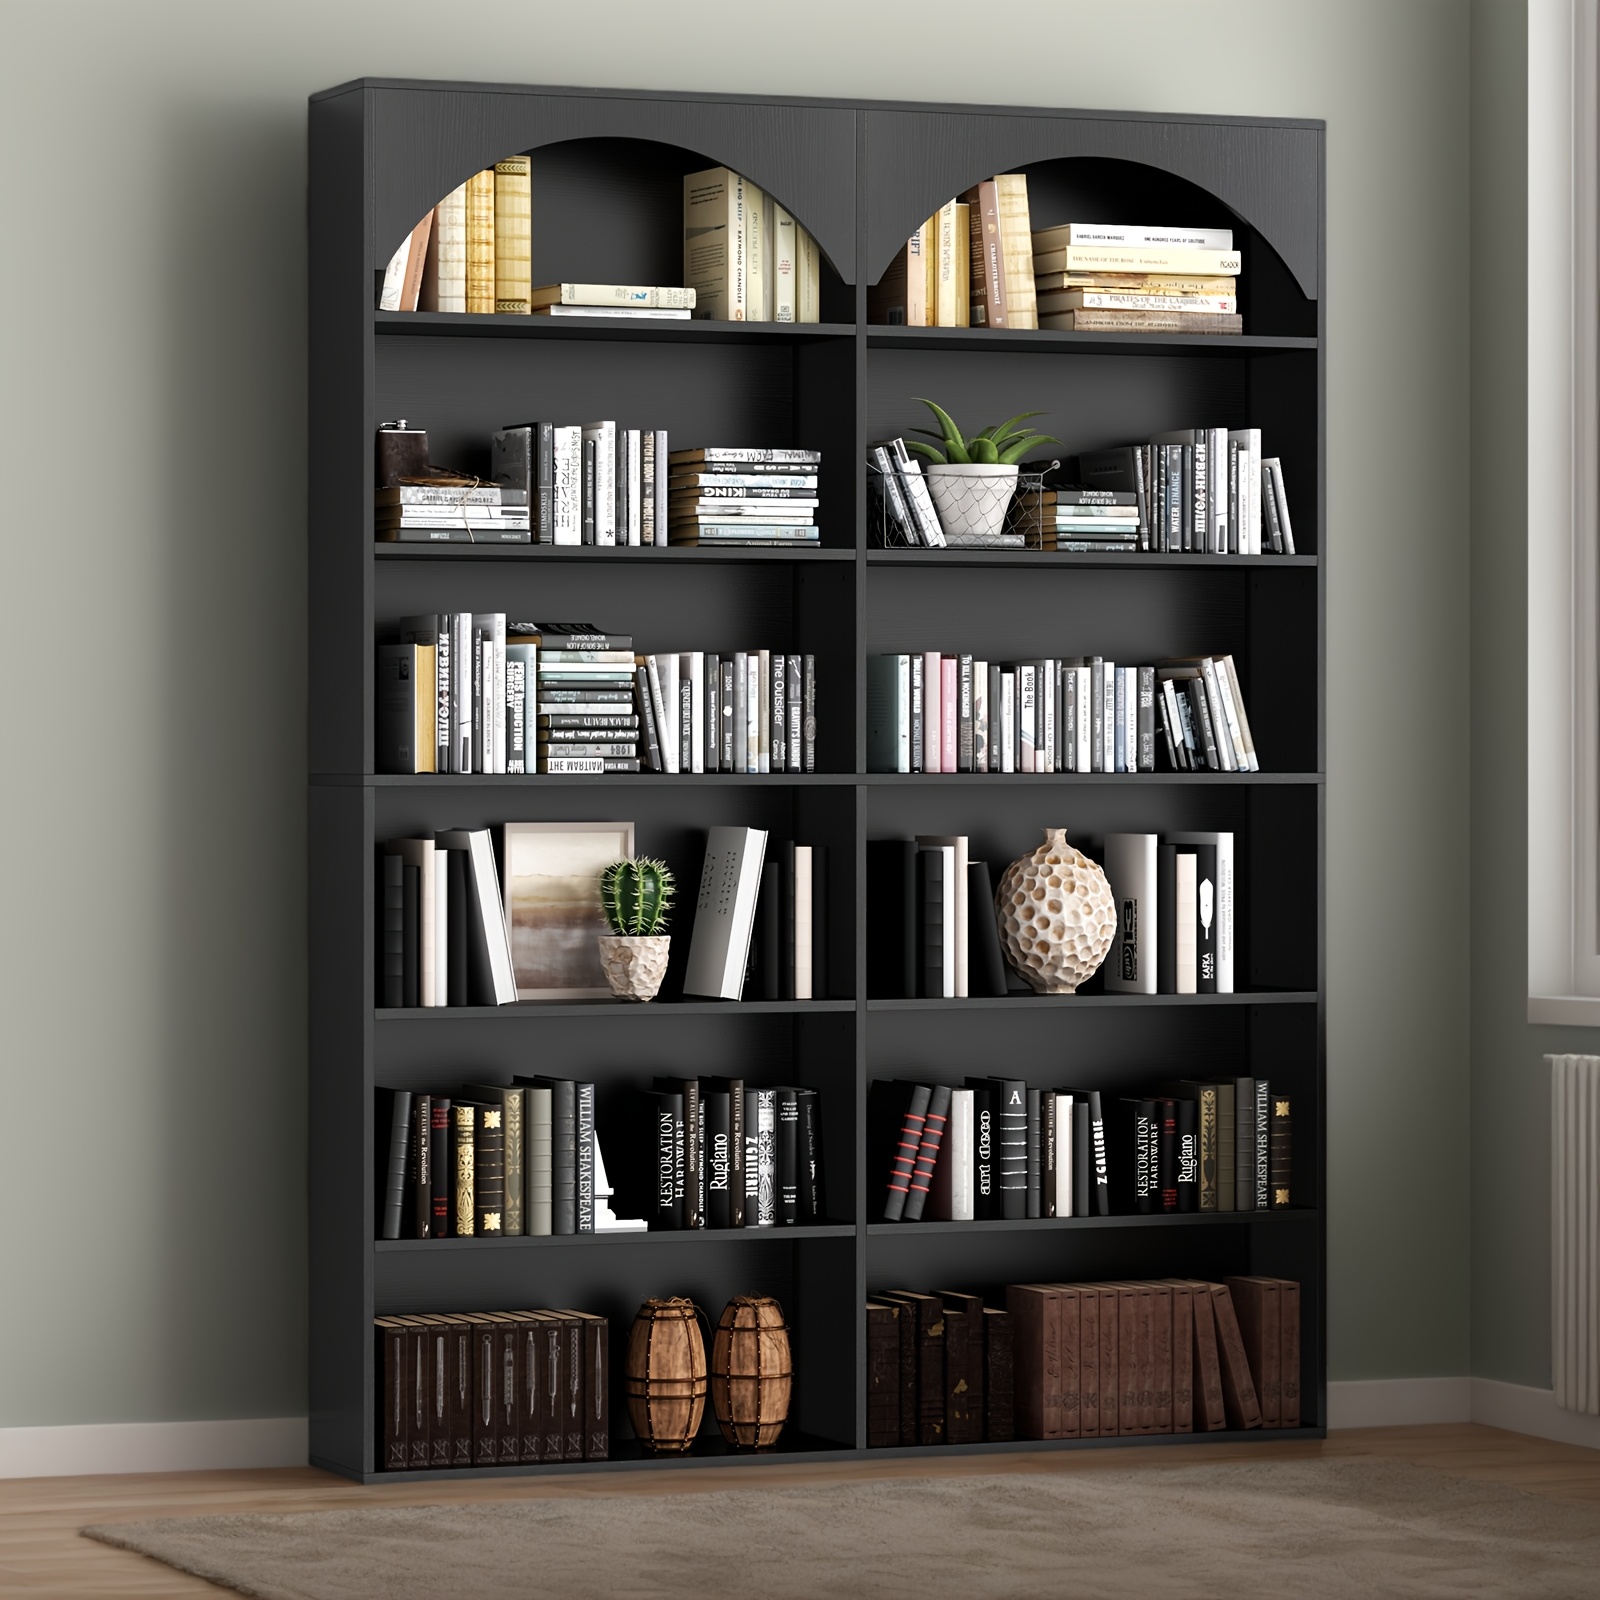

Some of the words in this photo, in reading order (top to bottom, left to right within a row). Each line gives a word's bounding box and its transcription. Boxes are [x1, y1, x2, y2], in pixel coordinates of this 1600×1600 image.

[1220, 261, 1239, 269] PICADOR
[1109, 295, 1140, 304] PIRATES
[1141, 296, 1151, 304] OF
[1170, 298, 1210, 306] CARIBBEAN
[1196, 443, 1206, 490] ИРВИН
[421, 495, 442, 503] GABRIEL
[704, 488, 744, 497] KING
[1171, 471, 1179, 505] FINANCE
[1171, 507, 1179, 533] WATER
[1196, 493, 1206, 533] УЭЛШ
[439, 633, 449, 692] ИРВИН
[514, 662, 524, 692] PENIS
[775, 658, 784, 678] The
[1024, 672, 1033, 692] Book
[775, 681, 784, 726] Outsider
[1024, 694, 1033, 709] The
[439, 695, 449, 747] УЭЛШ
[514, 693, 524, 751] REDUCTION
[583, 717, 608, 726] BEAUTY
[609, 717, 630, 726] BLACK
[791, 706, 800, 738] GRAVITY'S
[611, 745, 630, 755] 1984
[791, 738, 800, 768] RAINBOW
[1047, 733, 1053, 742] OF
[1124, 901, 1133, 943] 13
[1202, 953, 1210, 979] KAFKA
[1009, 1091, 1022, 1105] A
[1257, 1083, 1268, 1131] WILLIAM
[579, 1086, 592, 1144] WILLIAM
[745, 1136, 758, 1145] Z
[980, 1110, 991, 1160] deco
[1093, 1118, 1108, 1174] GALLERIE
[660, 1112, 673, 1208] RESTORATION
[710, 1133, 731, 1190] Rugiano
[745, 1147, 758, 1198] GALLERIE
[1137, 1117, 1149, 1197] RESTORATION
[1178, 1134, 1198, 1182] Rugiano
[1257, 1134, 1268, 1208] SHAKESPEARE
[579, 1146, 592, 1231] SHAKESPEARE
[980, 1164, 991, 1196] art
[1098, 1176, 1108, 1186] Z
